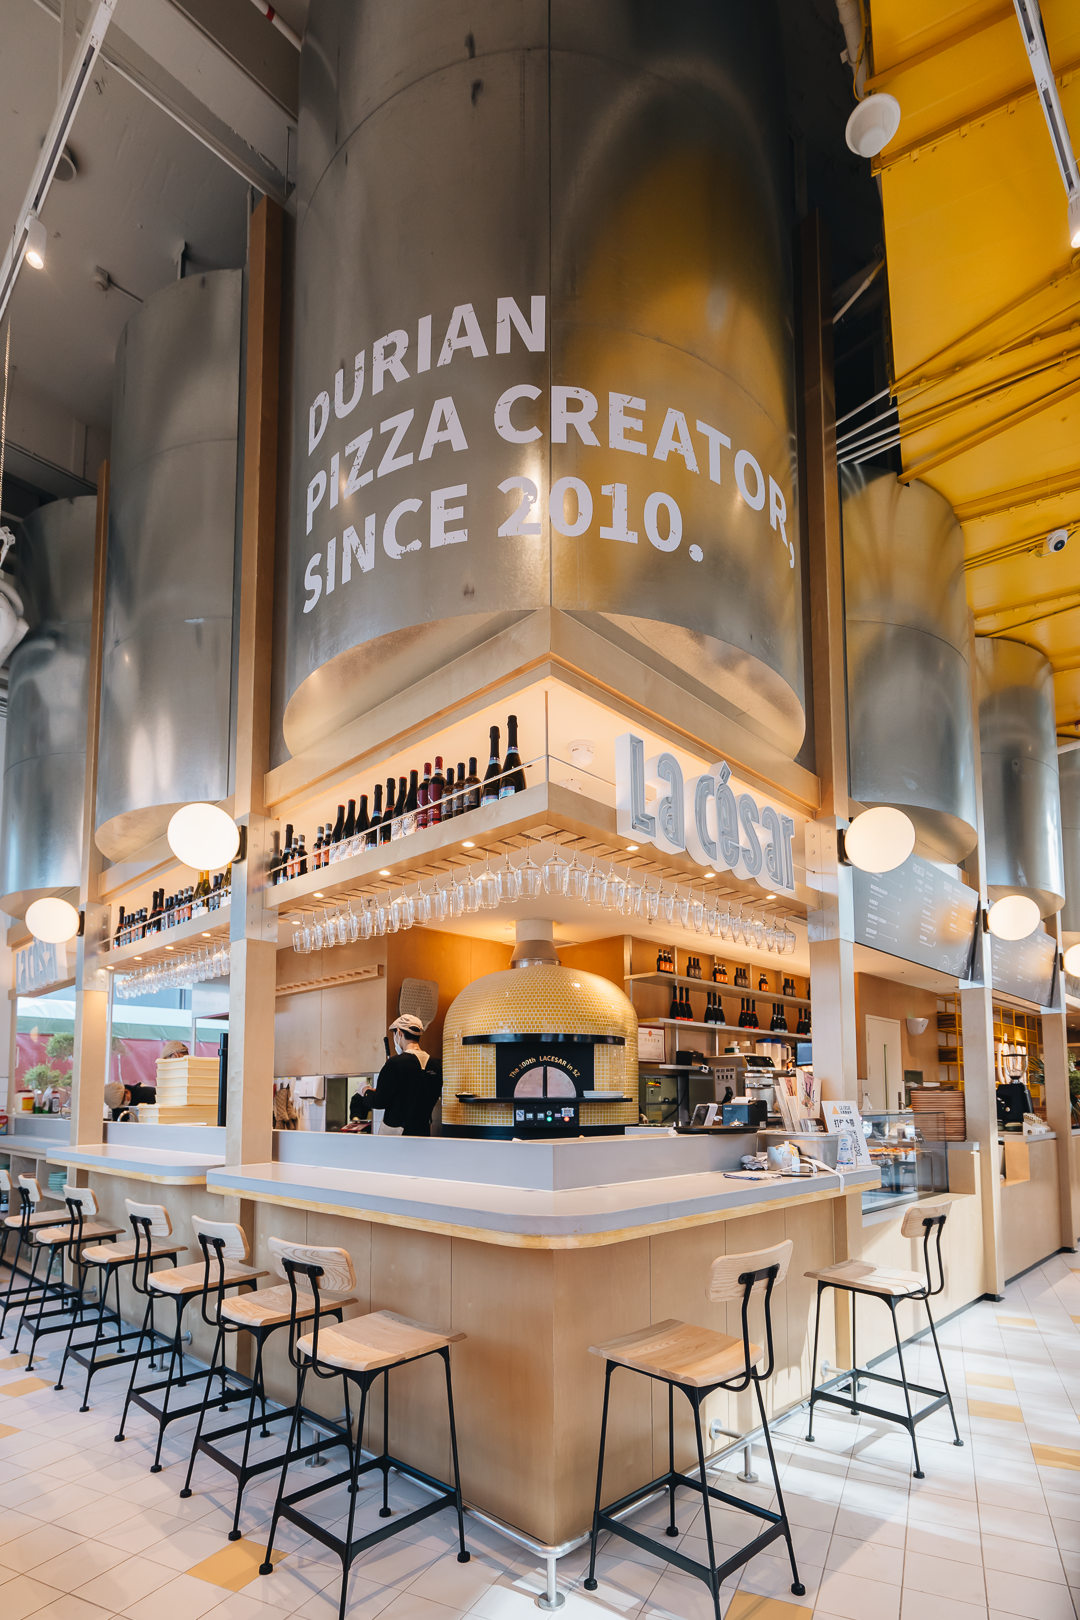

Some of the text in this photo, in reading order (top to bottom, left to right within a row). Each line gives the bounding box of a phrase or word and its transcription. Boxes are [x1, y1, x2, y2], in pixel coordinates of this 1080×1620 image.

[308, 295, 546, 457] DURIAN
[302, 475, 704, 614] SINCE 2010.
[306, 384, 795, 569] PIZZA CREATOR,
[509, 1067, 520, 1079] The
[519, 1057, 537, 1070] 100th
[539, 1055, 567, 1067] LACESAR
[566, 1063, 573, 1071] in
